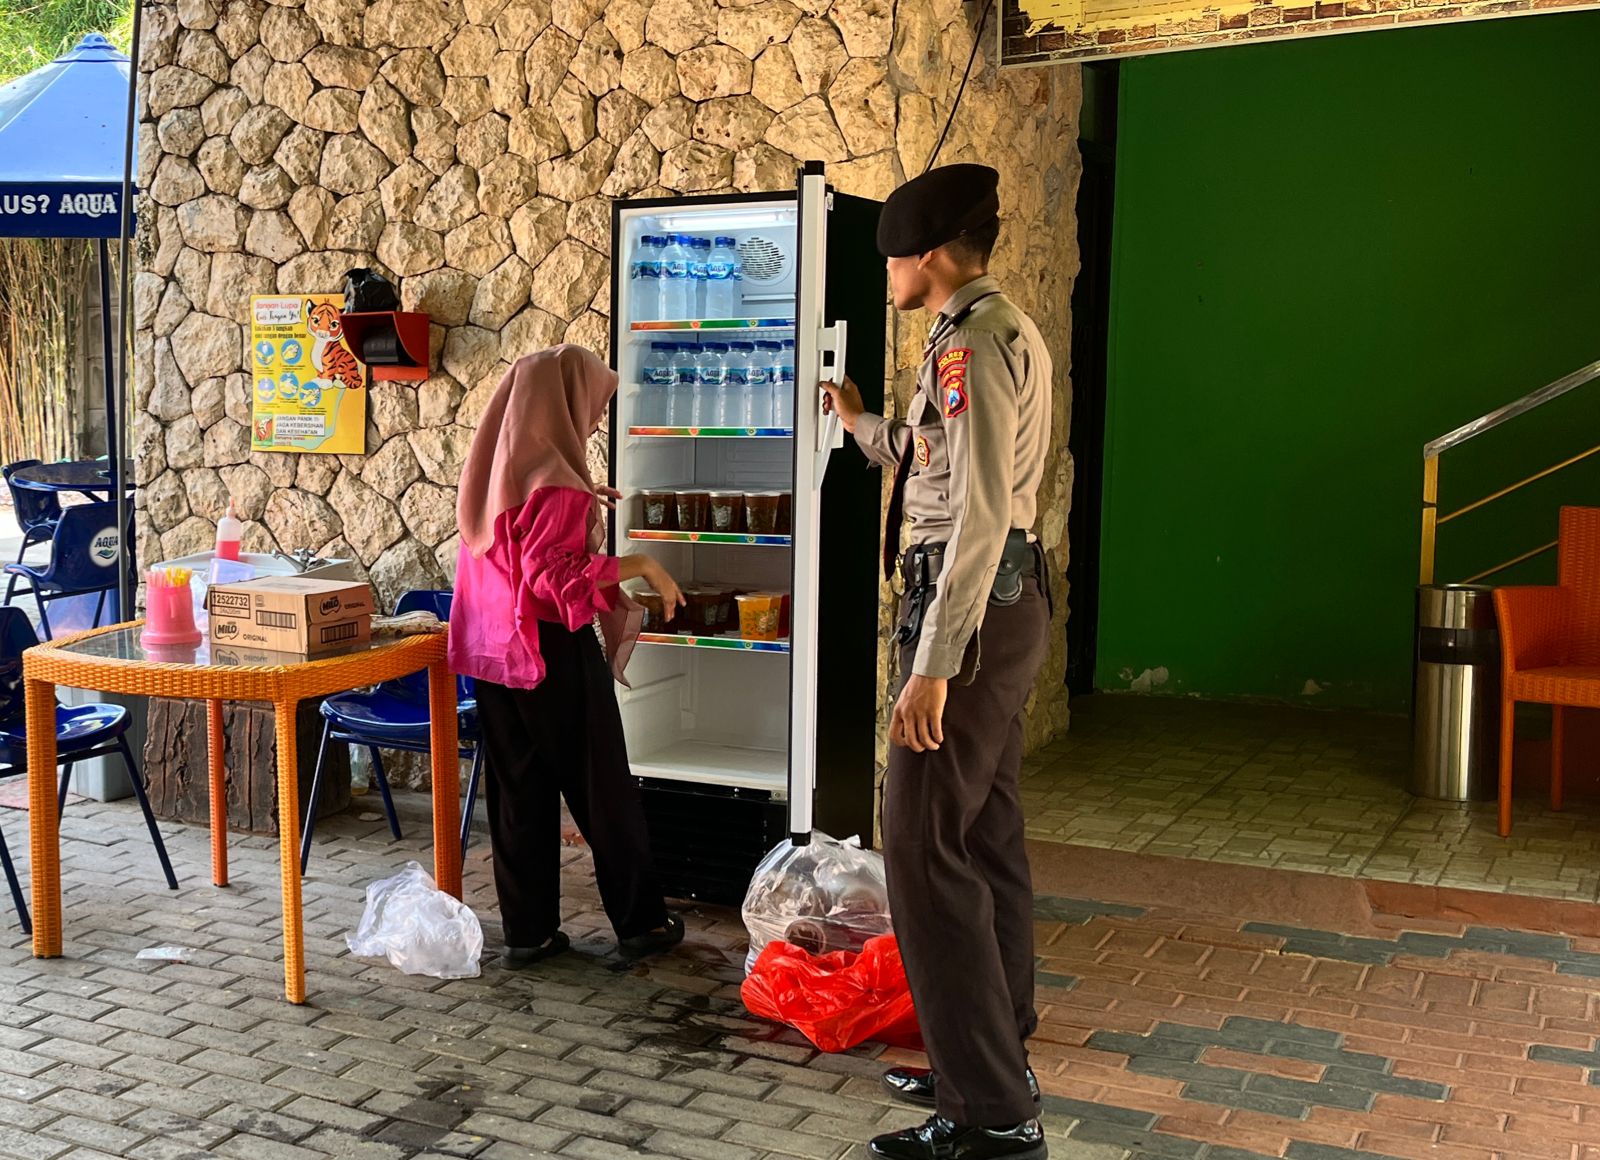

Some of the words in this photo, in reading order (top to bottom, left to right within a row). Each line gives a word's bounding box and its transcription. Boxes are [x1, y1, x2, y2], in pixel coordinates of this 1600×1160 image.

[0, 194, 50, 214] US?
[217, 625, 237, 634] MILO
[243, 633, 268, 642] ORIGINAL
